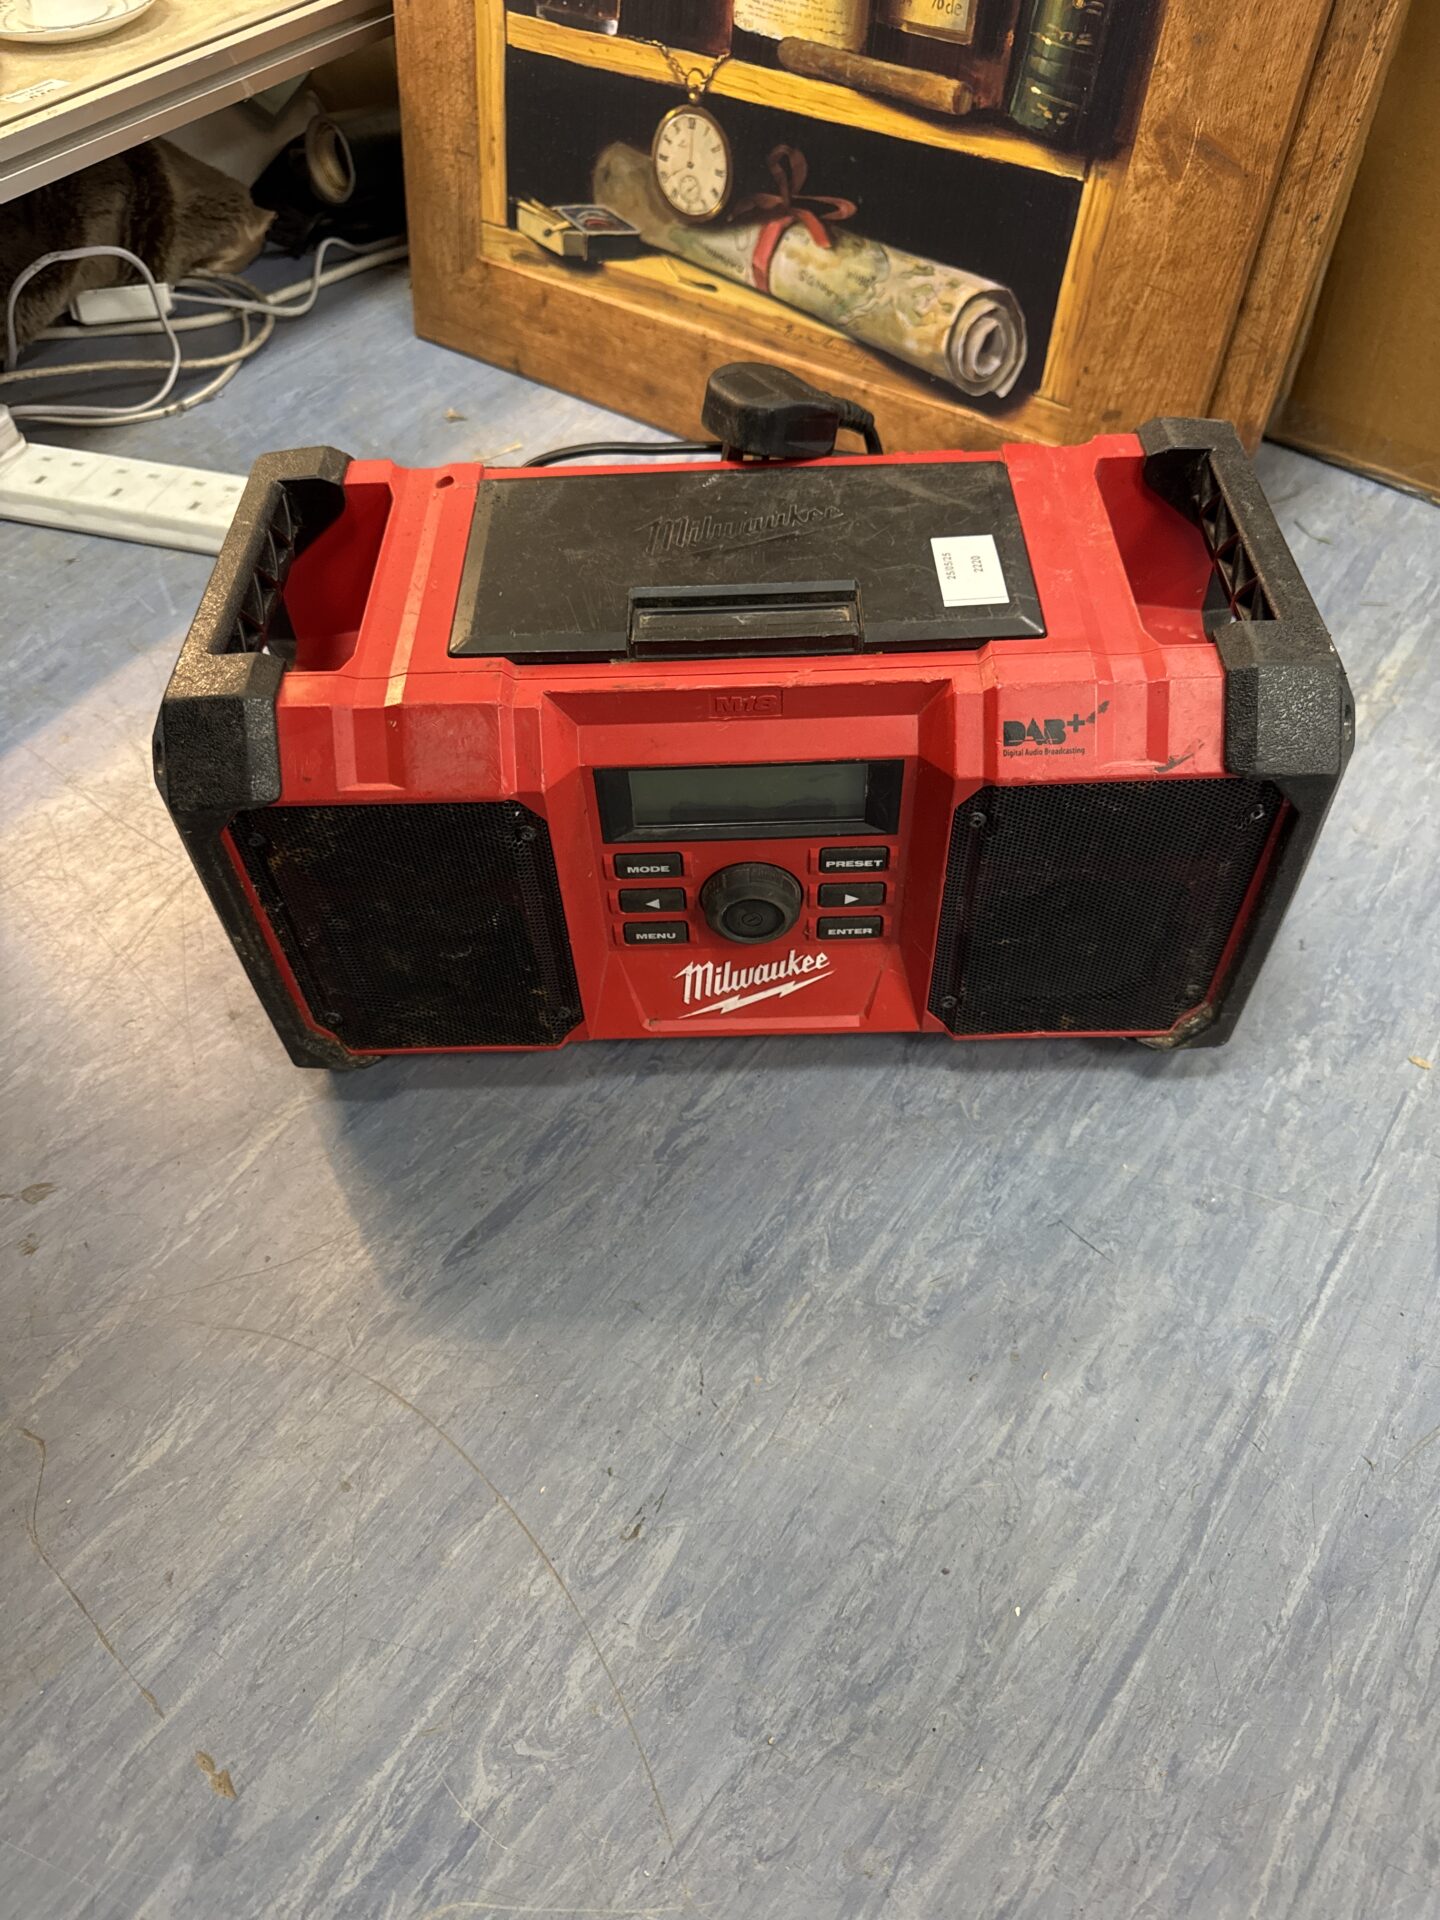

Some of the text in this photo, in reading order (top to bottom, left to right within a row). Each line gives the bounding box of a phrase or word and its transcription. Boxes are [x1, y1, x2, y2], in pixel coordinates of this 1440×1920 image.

[970, 555, 984, 573] 2220
[714, 694, 778, 713] M18
[1003, 713, 1085, 747] DAB+
[1003, 749, 1024, 757] Digital
[1044, 747, 1086, 756] Broadcasting
[825, 859, 883, 868] PRESET
[626, 865, 671, 874] MODE
[635, 932, 677, 940] MENU
[827, 927, 873, 935] ENTER
[672, 949, 831, 1005] Milwaukee
